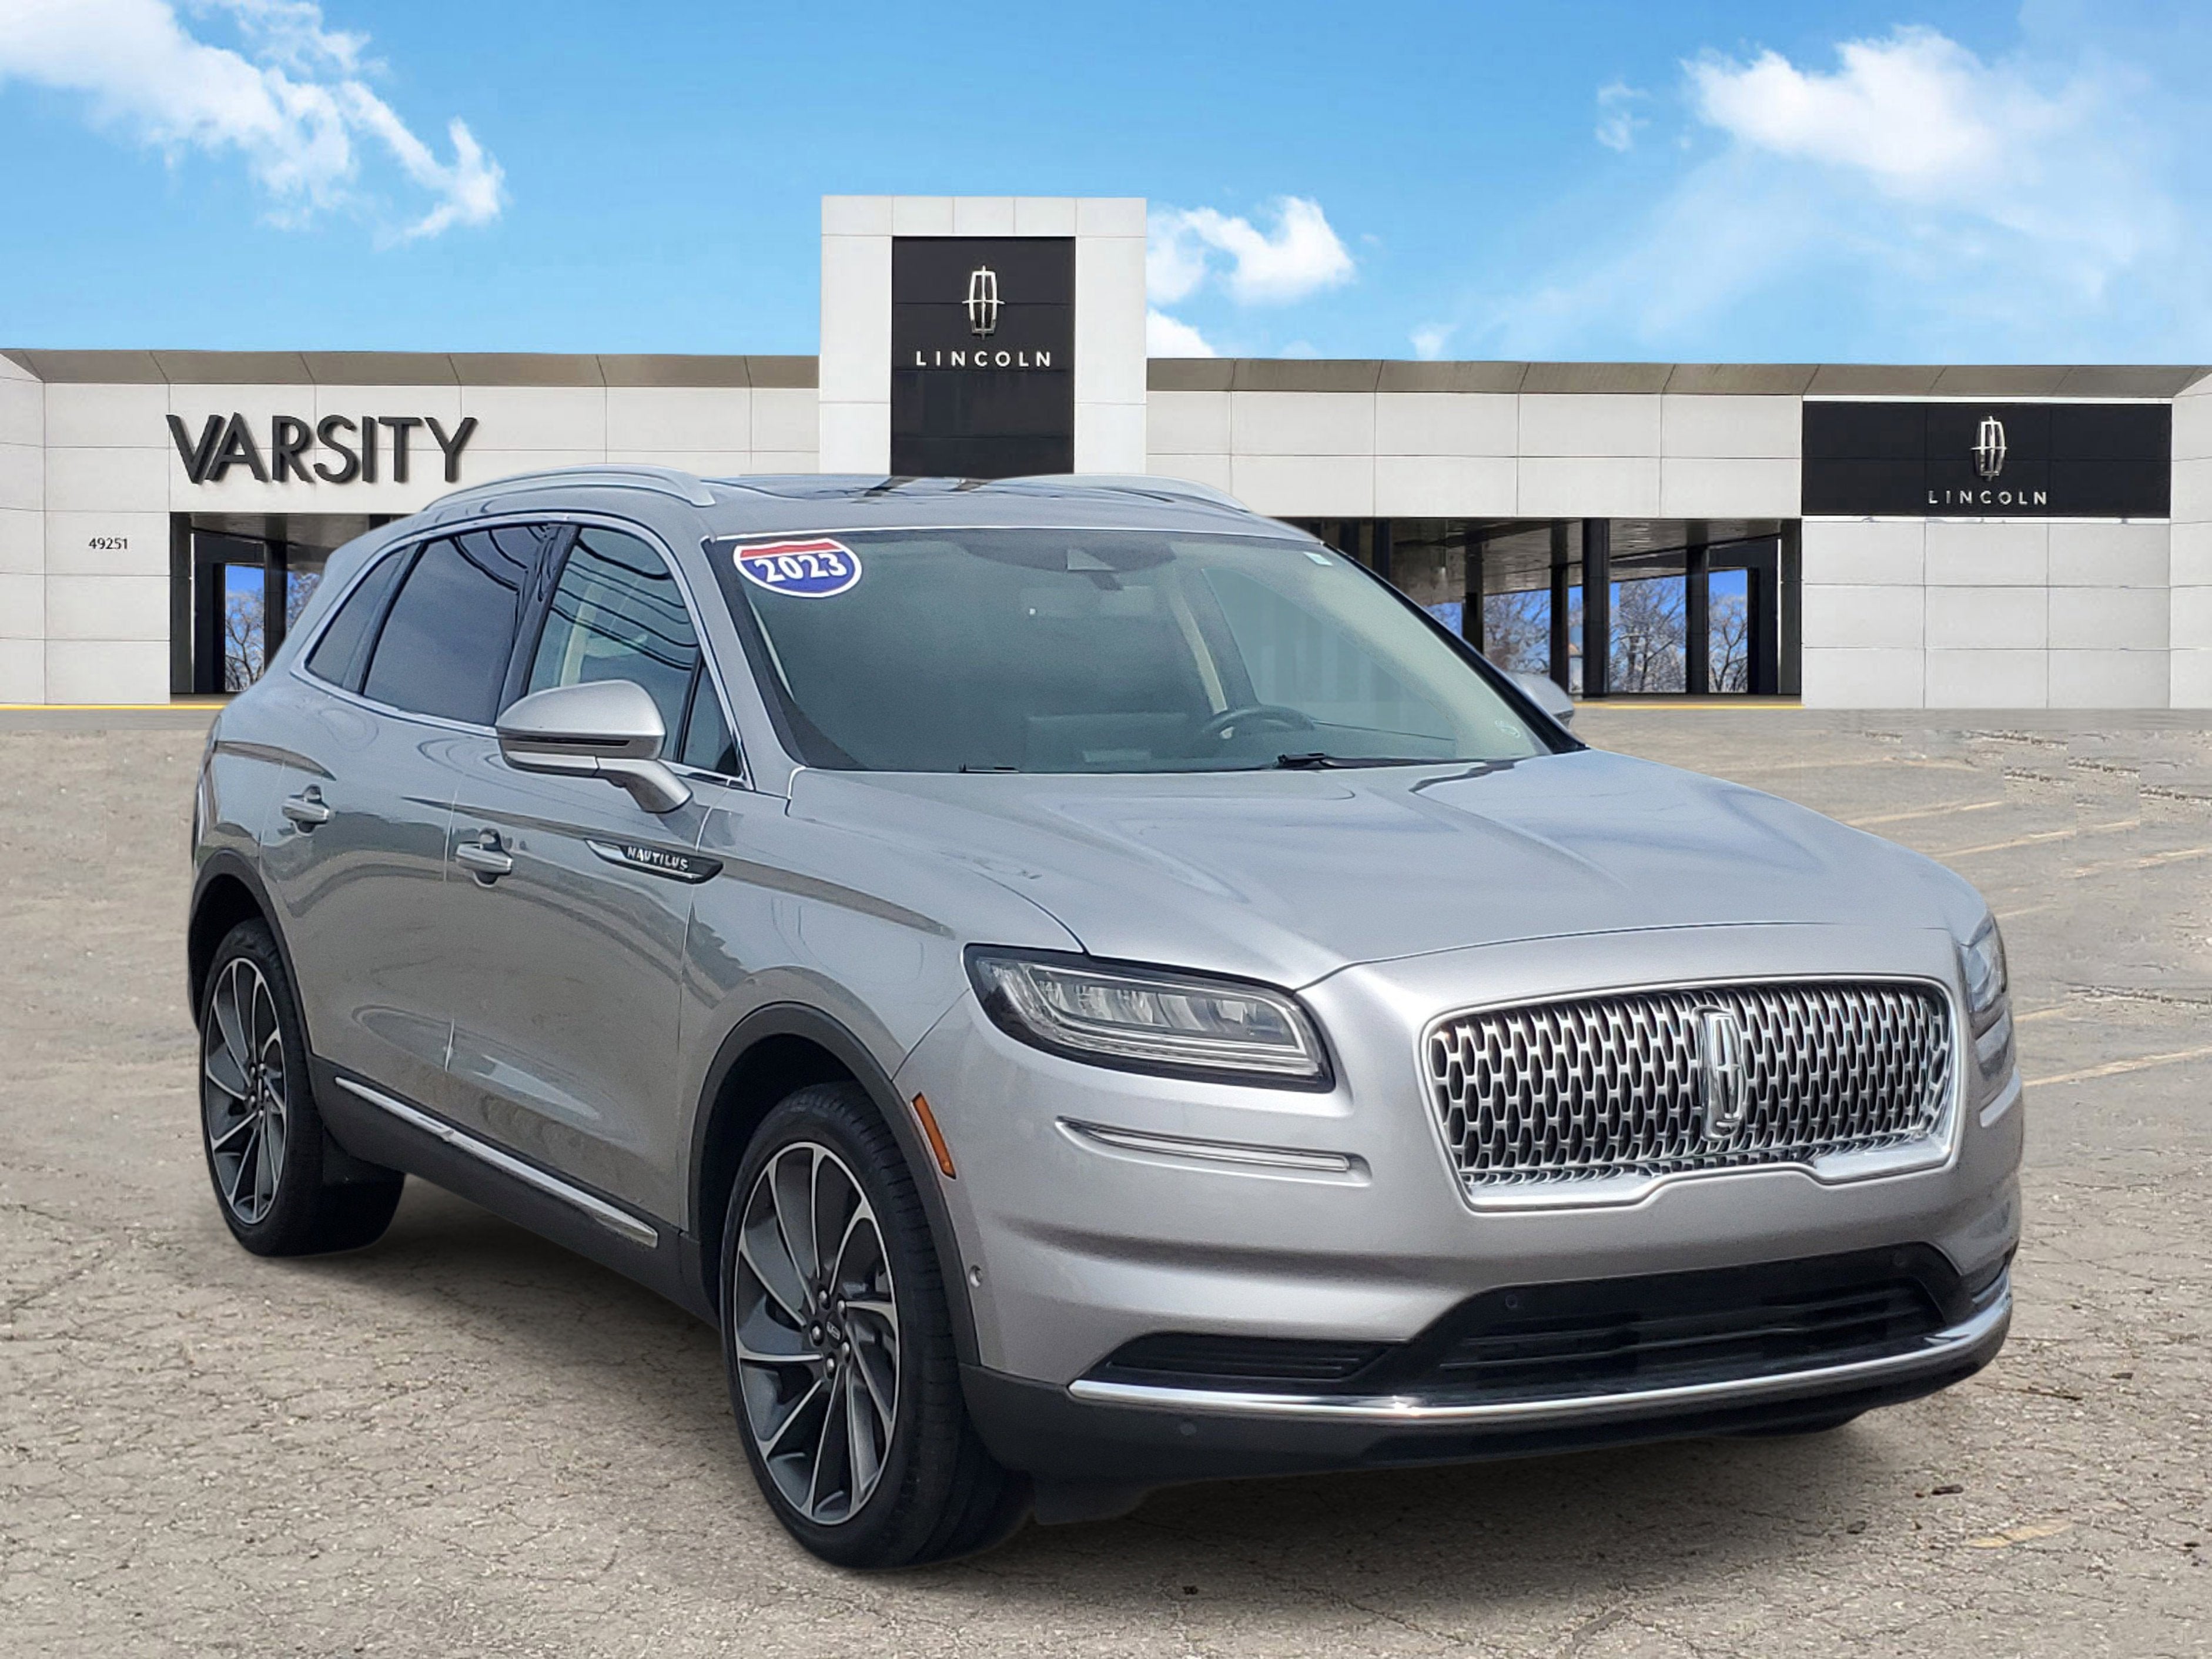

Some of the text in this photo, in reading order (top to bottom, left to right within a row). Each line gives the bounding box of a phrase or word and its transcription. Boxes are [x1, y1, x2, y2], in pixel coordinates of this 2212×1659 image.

[916, 350, 1050, 367] LINCOLN
[166, 412, 478, 484] VARSITY
[1928, 490, 2047, 505] LINCOLN
[88, 537, 128, 550] 49251
[754, 553, 848, 583] 2023
[627, 846, 688, 871] NAUTILUS
